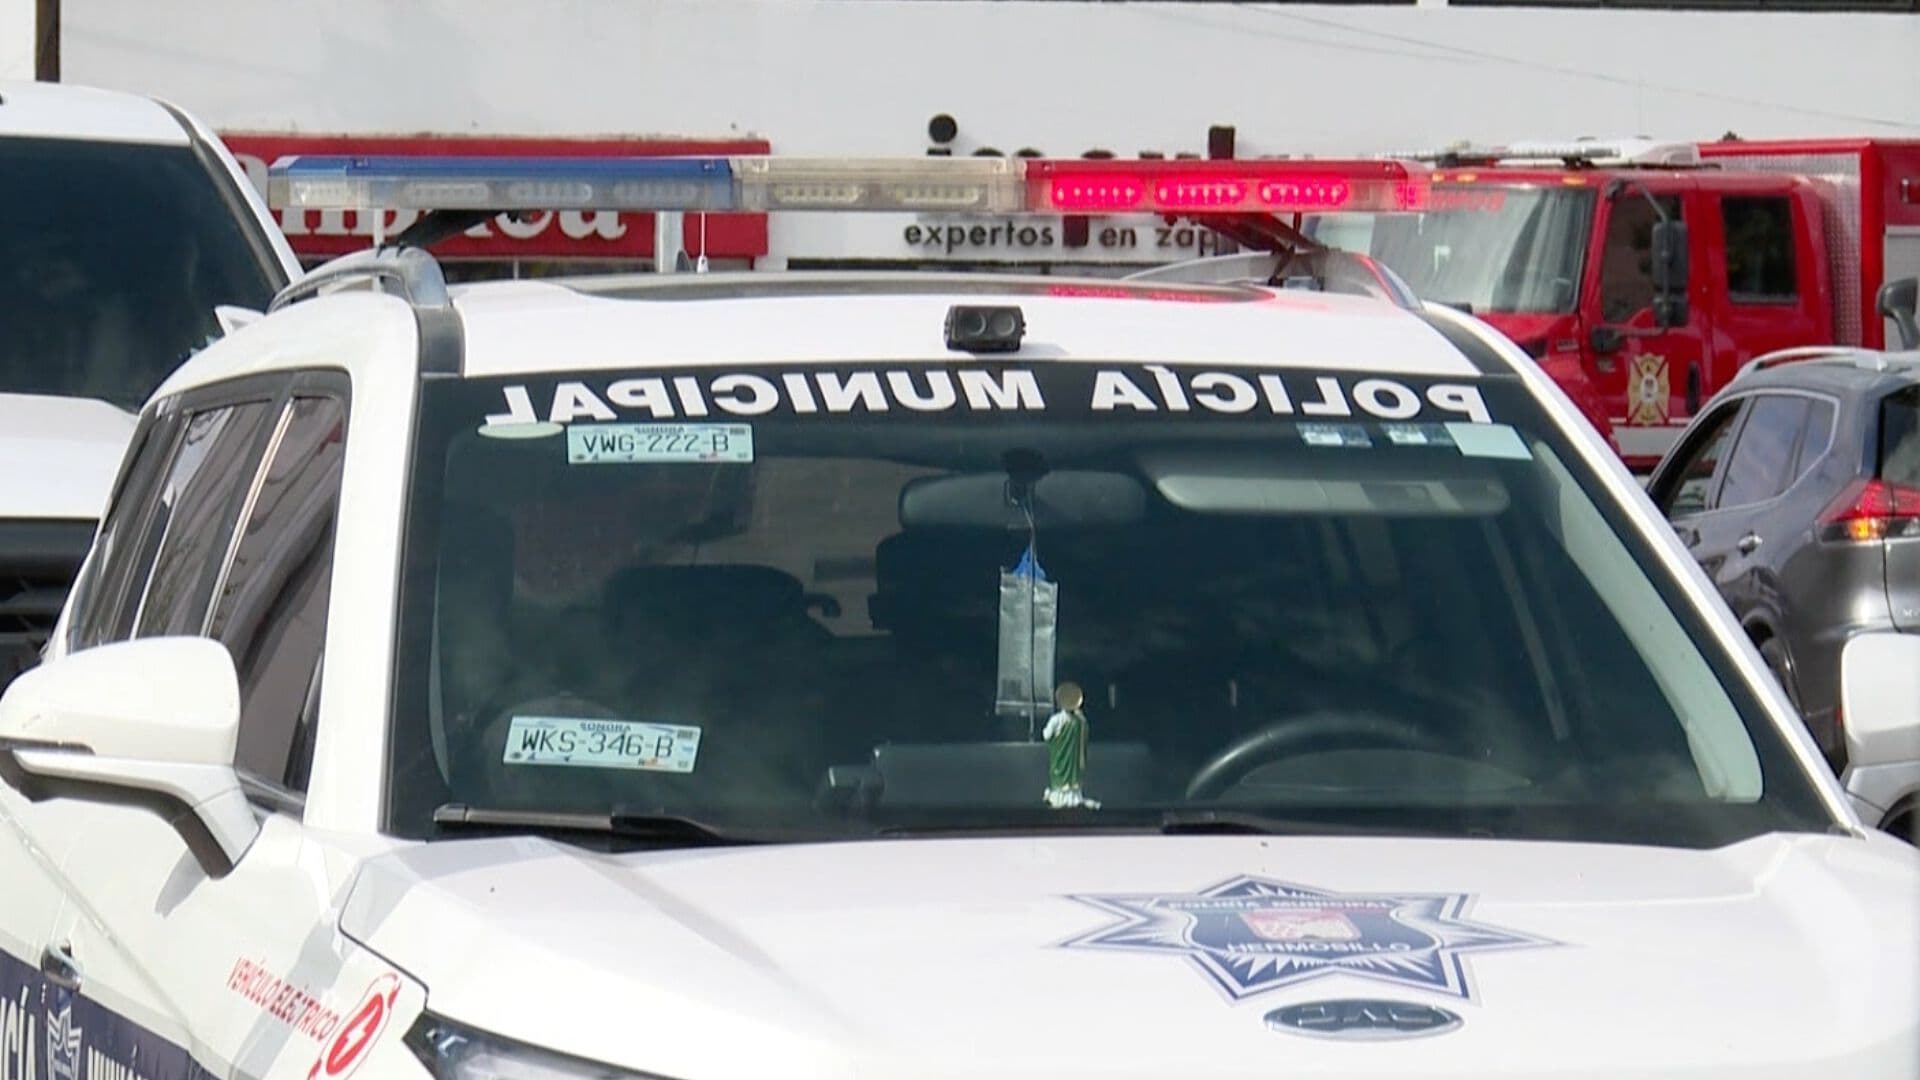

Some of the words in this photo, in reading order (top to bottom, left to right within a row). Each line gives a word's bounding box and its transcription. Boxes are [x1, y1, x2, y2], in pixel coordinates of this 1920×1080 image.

[904, 221, 1054, 254] expertos
[1098, 226, 1136, 247] en
[1155, 226, 1219, 256] zap
[583, 433, 729, 453] VWG-222-B
[579, 722, 632, 733] SONORA
[521, 728, 675, 759] WKS-346-B
[1227, 941, 1412, 952] HERMOSILLO
